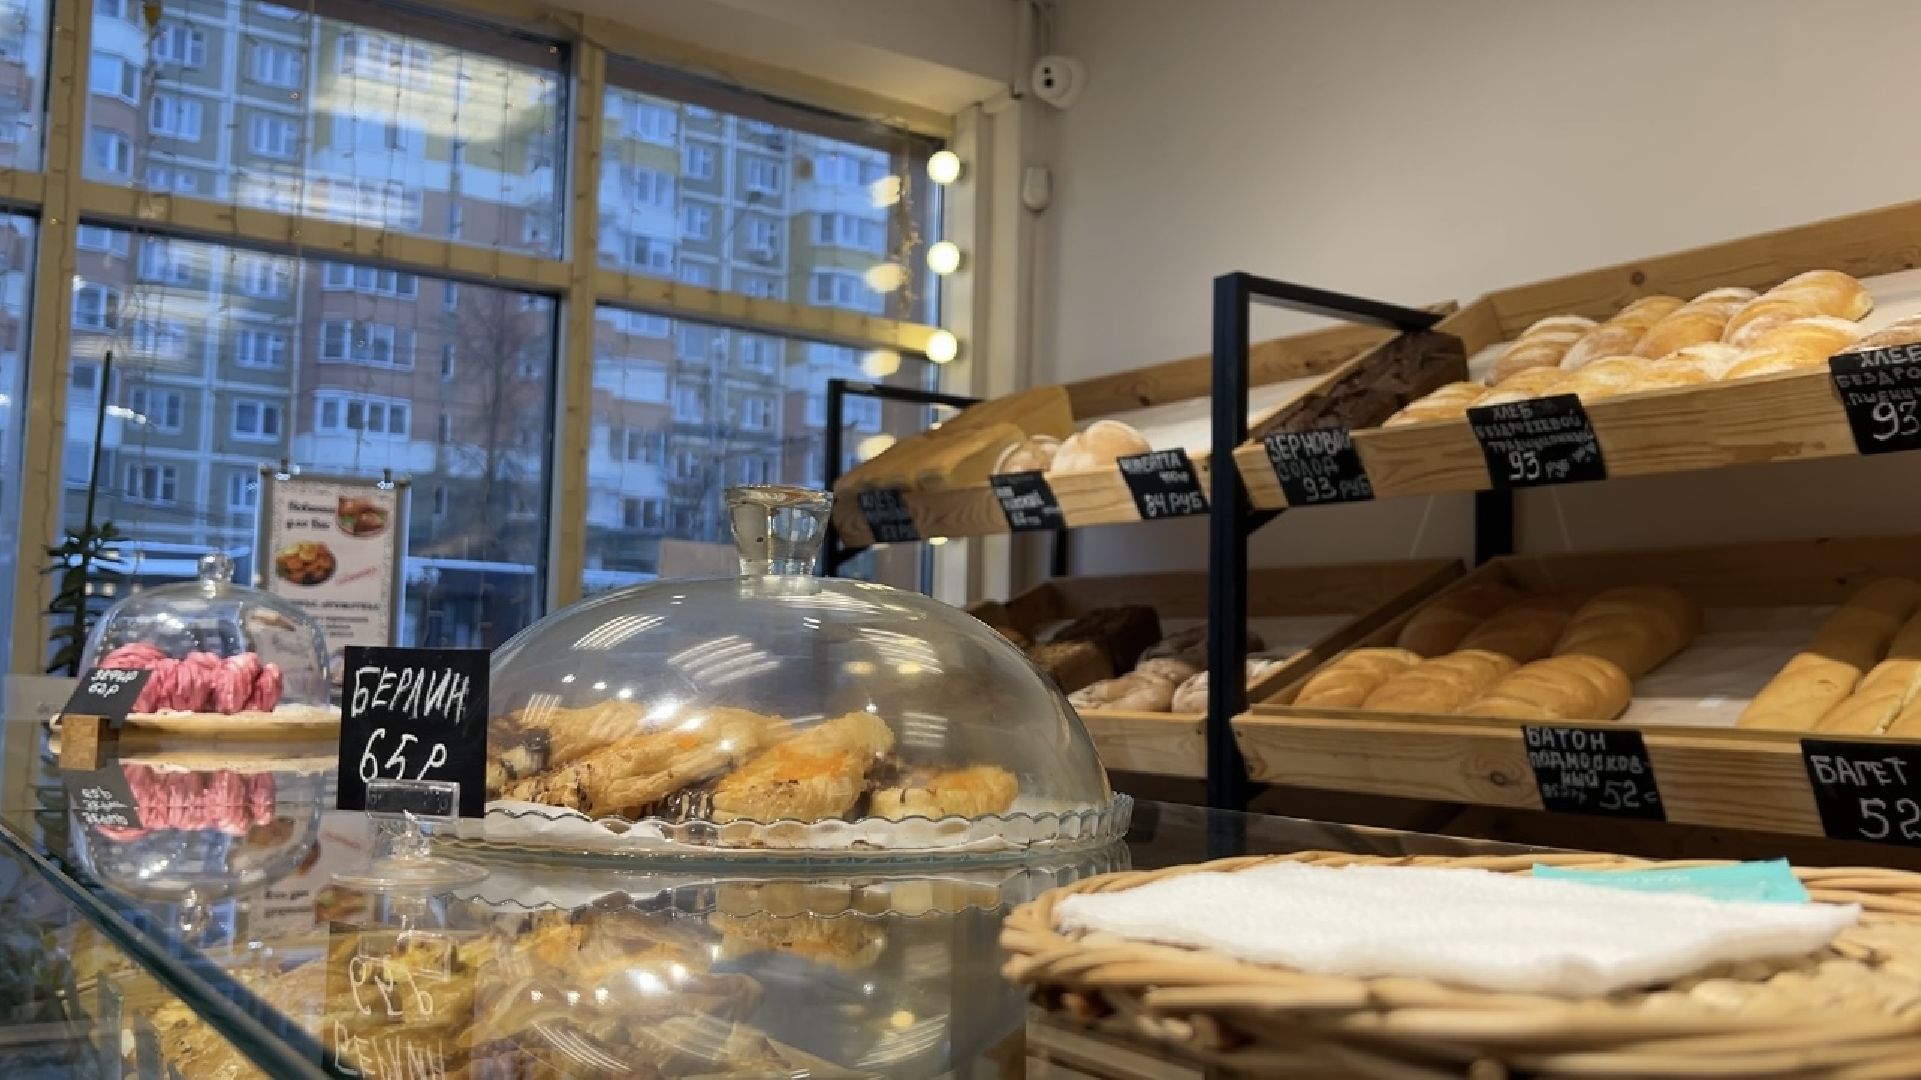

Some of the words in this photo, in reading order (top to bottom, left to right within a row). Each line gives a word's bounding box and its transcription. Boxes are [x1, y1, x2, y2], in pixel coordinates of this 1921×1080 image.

[1872, 400, 1920, 441] 93
[1508, 450, 1541, 480] 93
[1302, 476, 1337, 502] 93
[350, 666, 470, 725] БЕРЛИН
[1526, 726, 1607, 751] БАТОН
[1810, 754, 1908, 787] БАГЕТ
[1859, 797, 1921, 840] 52
